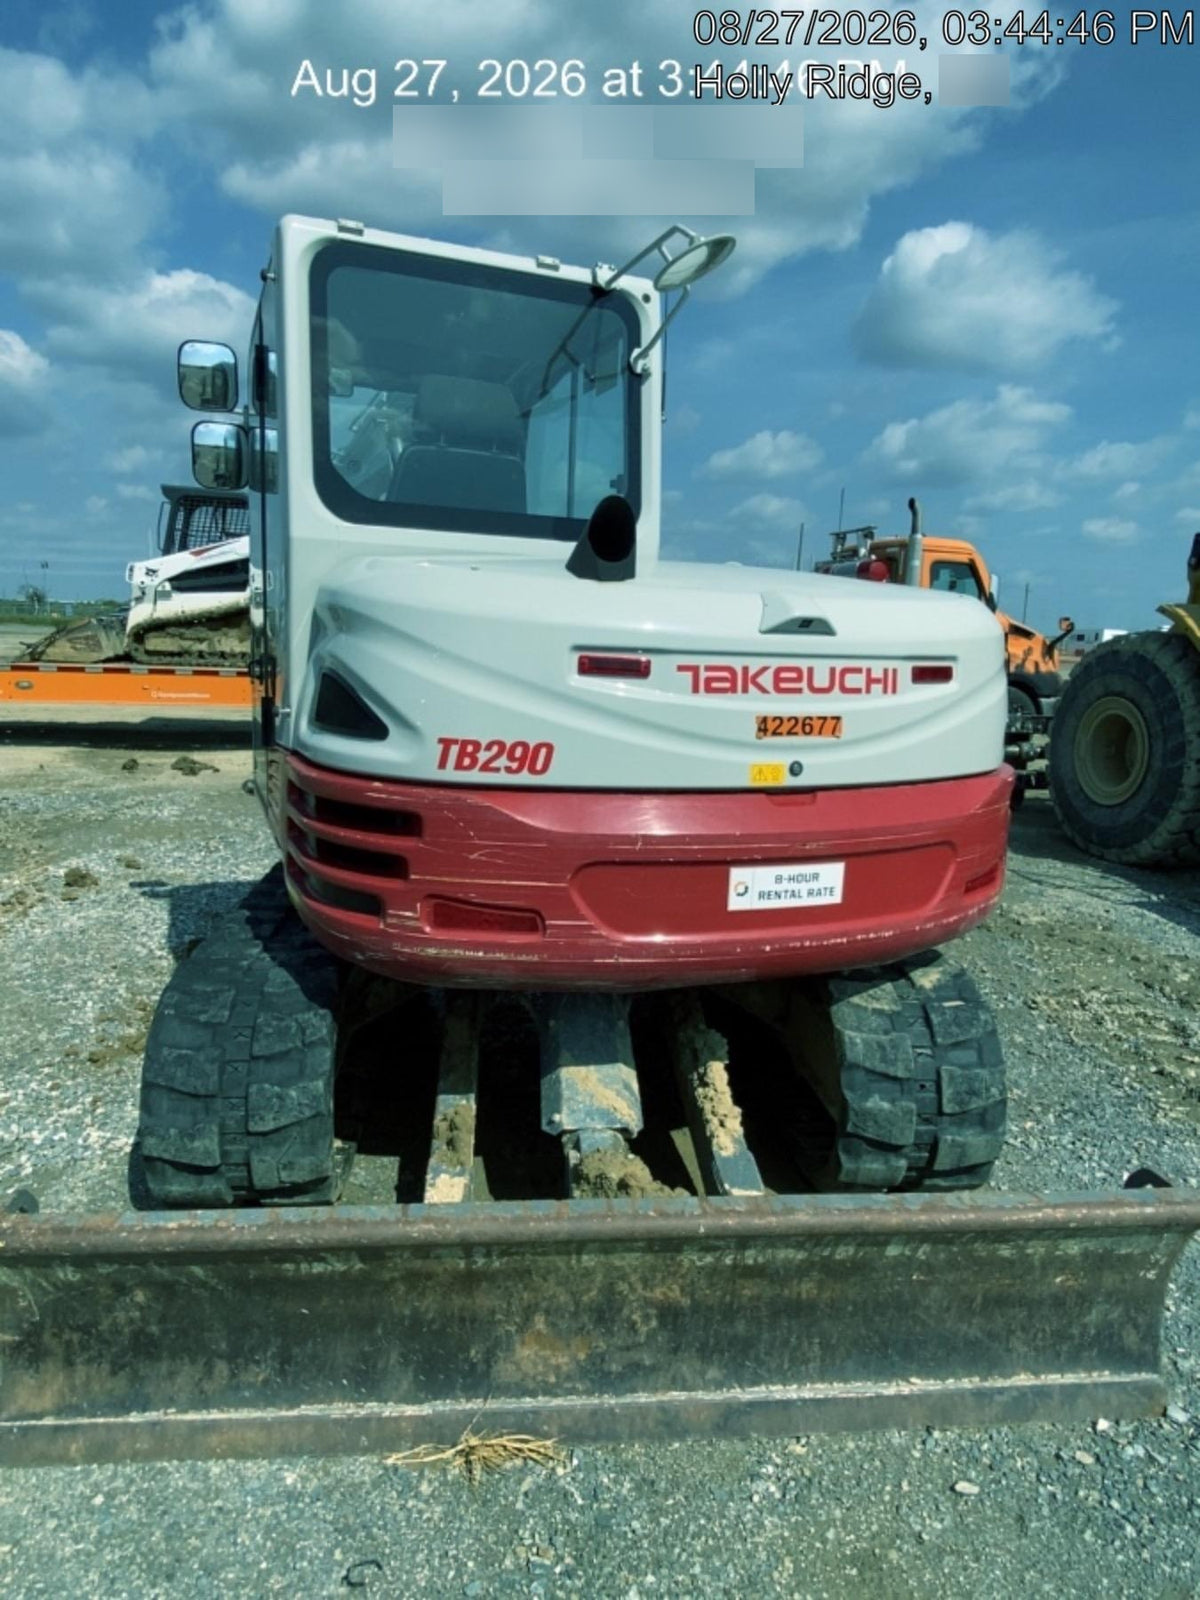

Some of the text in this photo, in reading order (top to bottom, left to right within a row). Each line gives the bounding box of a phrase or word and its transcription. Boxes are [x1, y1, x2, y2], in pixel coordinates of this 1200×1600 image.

[757, 715, 842, 737] 422677
[437, 737, 555, 776] TB290
[758, 886, 836, 901] RENTAL RATE
